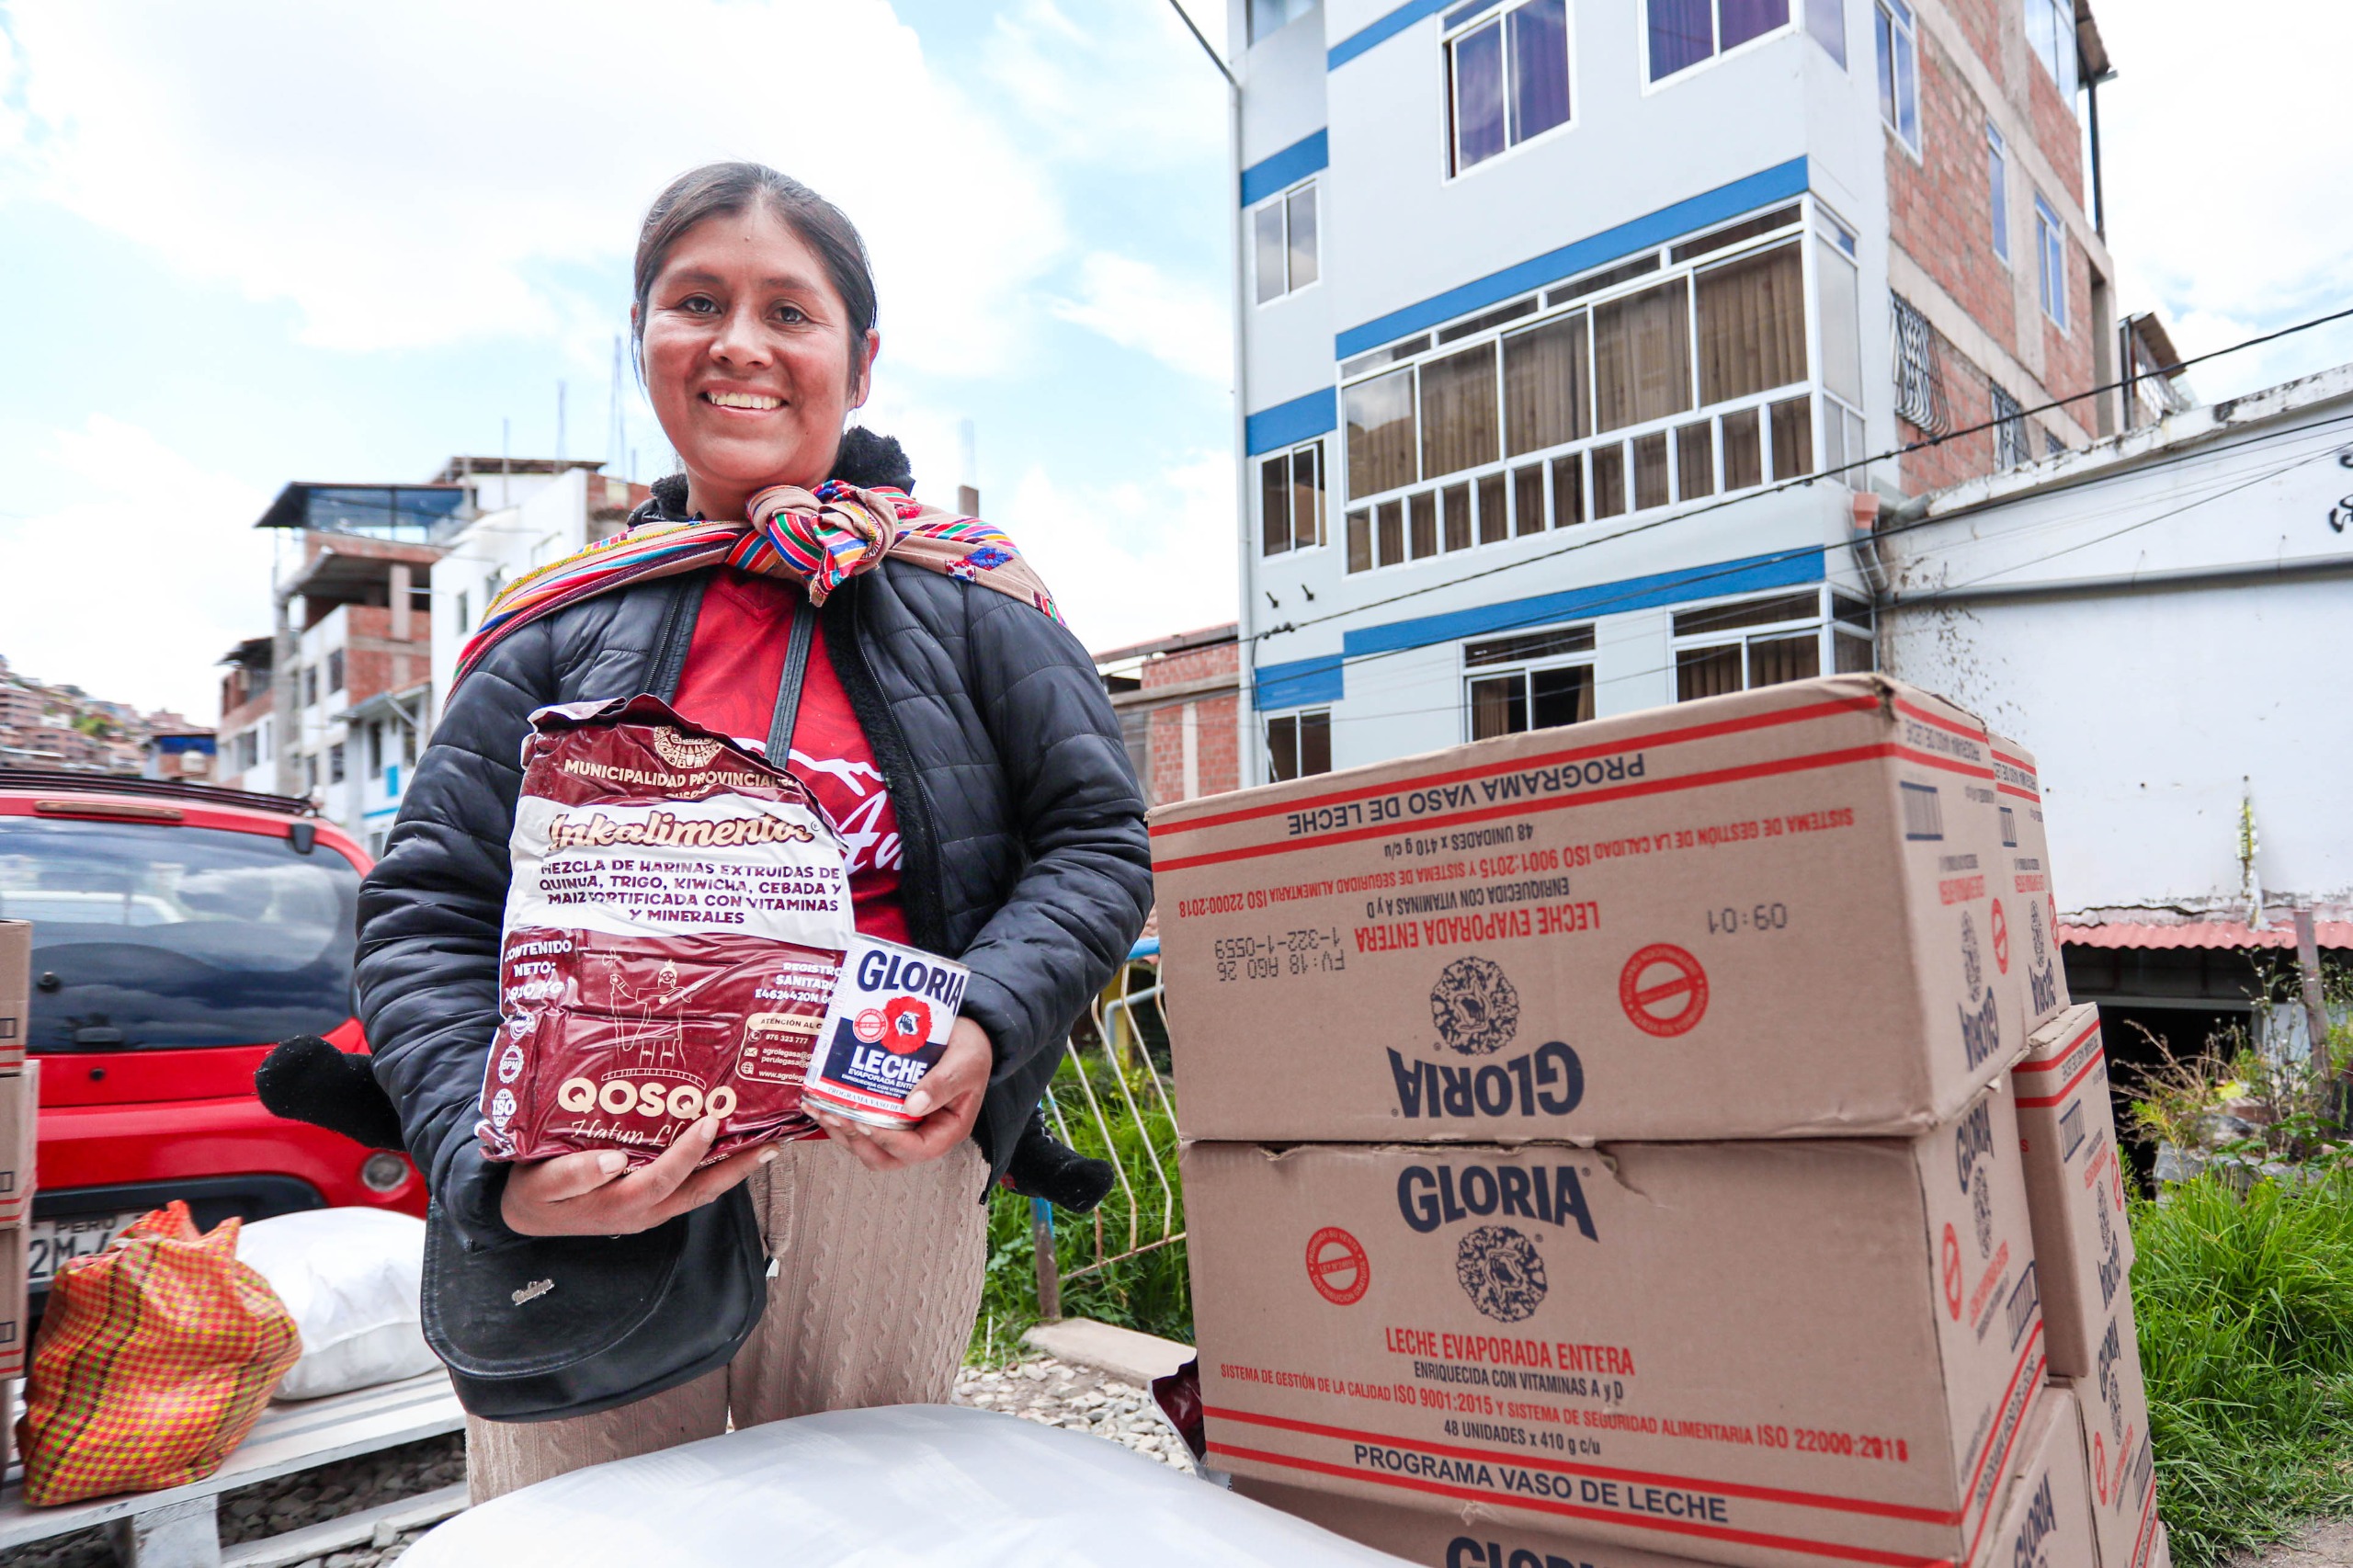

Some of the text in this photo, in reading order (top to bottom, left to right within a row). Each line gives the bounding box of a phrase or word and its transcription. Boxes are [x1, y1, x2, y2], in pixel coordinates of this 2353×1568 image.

[564, 759, 686, 787] MUNICIPALIDAD
[689, 772, 779, 788] PROVINCIAL
[1287, 753, 1645, 835] PROGRAMA VASO DE LECHE
[1451, 826, 1514, 851] UNIDADES
[1517, 824, 1534, 841] 48
[1383, 842, 1403, 860] c/u
[1416, 837, 1438, 856] 410
[541, 859, 840, 880] MEZCLA DE HARINAS EXTRUIDAS DE
[1178, 807, 1854, 918] SISTEMA DE GESTIÓN DE LA CALIDAD ISO 9001:2015 Y SISTEMA DE SEGURIDAD ALIMENTARIA ISO 22000:2018
[609, 875, 667, 890] TRIGO,
[674, 878, 753, 893] KIWICHA,
[758, 881, 826, 895] CEBADA
[831, 882, 841, 895] Y
[548, 892, 586, 905] MAIZ
[704, 894, 742, 907] CON
[745, 897, 838, 912] VITAMINAS
[1367, 878, 1570, 919] ENRIQUECIDA CON VITAMINAS A y D
[629, 909, 745, 924] Y MINERALES
[1354, 901, 1601, 954] LECHE EVAPORADA ENTERA
[1707, 903, 1788, 936] 09:01
[505, 939, 573, 962] CONTENIDO
[513, 961, 557, 978] NETO:
[782, 961, 842, 977] REGISTRO
[1219, 961, 1237, 982] 26
[1246, 956, 1279, 979] AGO
[857, 949, 965, 1016] GLORIA
[761, 1017, 801, 1028] ATENCIÓN
[1957, 985, 2000, 1073] GLORIA
[780, 1035, 794, 1043] 323
[850, 1045, 928, 1083] LECHE
[848, 1068, 915, 1090] EVAPORADA ENTE
[1386, 1040, 1585, 1119] GLORIA
[492, 1099, 517, 1116] ISO
[557, 1077, 737, 1121] QOSQO
[827, 1086, 869, 1104] PROGRAMA
[870, 1097, 889, 1108] VASO
[891, 1103, 900, 1111] DE
[571, 1119, 644, 1145] Hatun
[1956, 1099, 1995, 1195] GLORIA
[1397, 1165, 1599, 1244] GLORIA
[1385, 1326, 1636, 1377] LECHE EVAPORADA ENTERA
[1414, 1360, 1623, 1403] ENRIQUECIDA CON VITAMINAS A y D
[1221, 1363, 1909, 1463] SISTEMA DE GESTIÓN DE LA CALIDAD ISO 9001:2015 Y SISTEMA DE SEGURIDAD ALIMENTARIA ISO 22000:2018
[1444, 1420, 1601, 1456] 48 UNIDADES x 410 g c/u
[1354, 1443, 1729, 1523] PROGRAMA VASO DE LECHE
